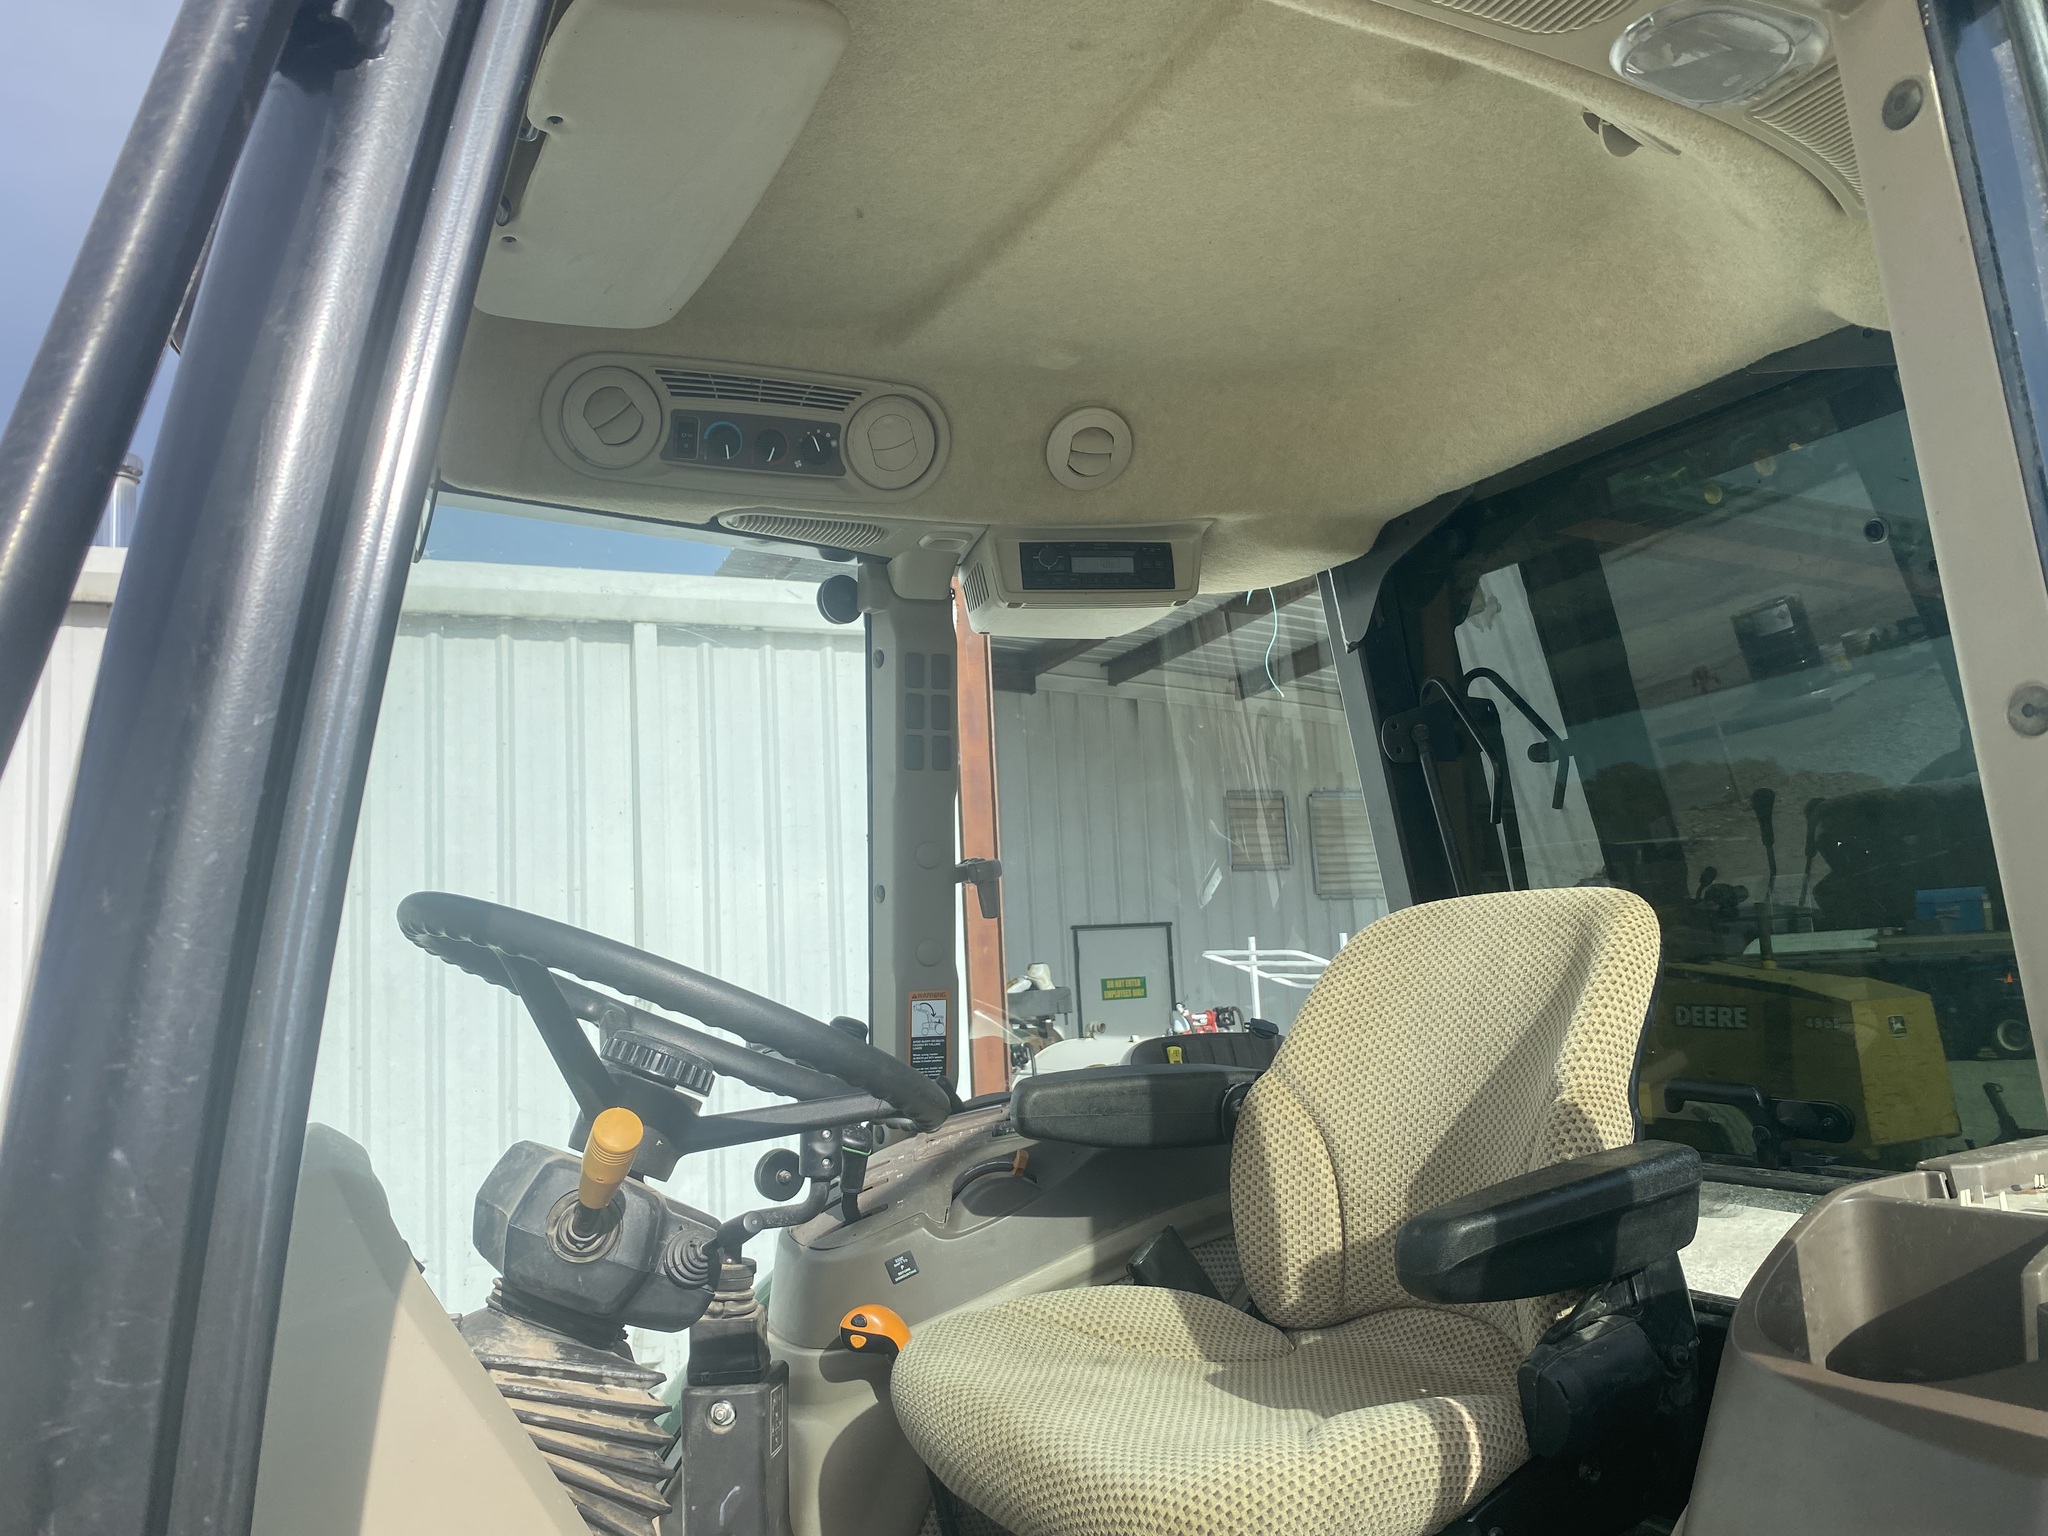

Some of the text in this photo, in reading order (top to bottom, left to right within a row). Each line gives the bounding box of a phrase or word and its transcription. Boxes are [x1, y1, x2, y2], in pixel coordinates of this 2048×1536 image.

[1115, 979, 1125, 988] NOT
[1125, 979, 1141, 987] ENTER
[1675, 1005, 1748, 1028] DEERE
